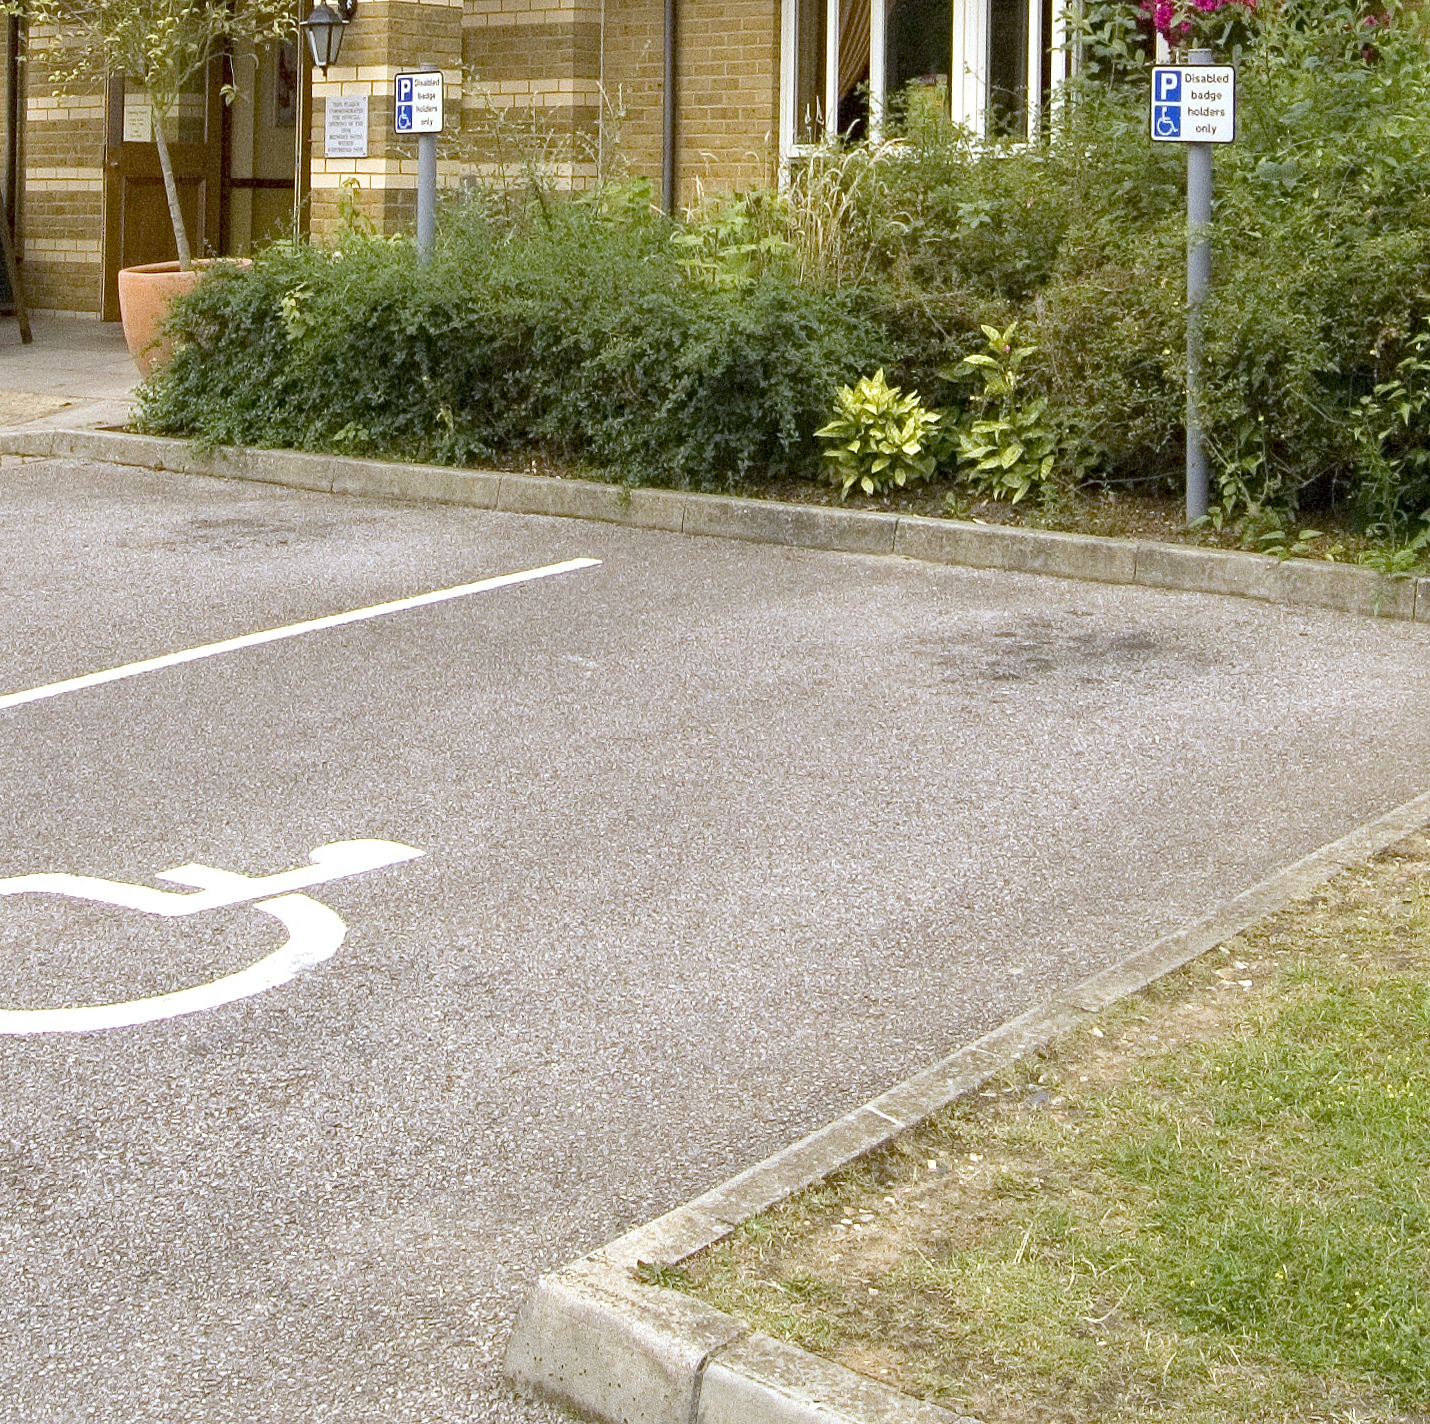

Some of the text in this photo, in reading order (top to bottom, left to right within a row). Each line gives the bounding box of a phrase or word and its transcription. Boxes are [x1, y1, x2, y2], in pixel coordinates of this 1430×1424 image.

[414, 77, 440, 87] Disabled
[1184, 73, 1230, 84] Disabled
[400, 78, 412, 102] P
[1160, 72, 1178, 101] P
[1191, 90, 1223, 102] badge
[1187, 106, 1226, 117] holders
[1195, 123, 1217, 135] only
